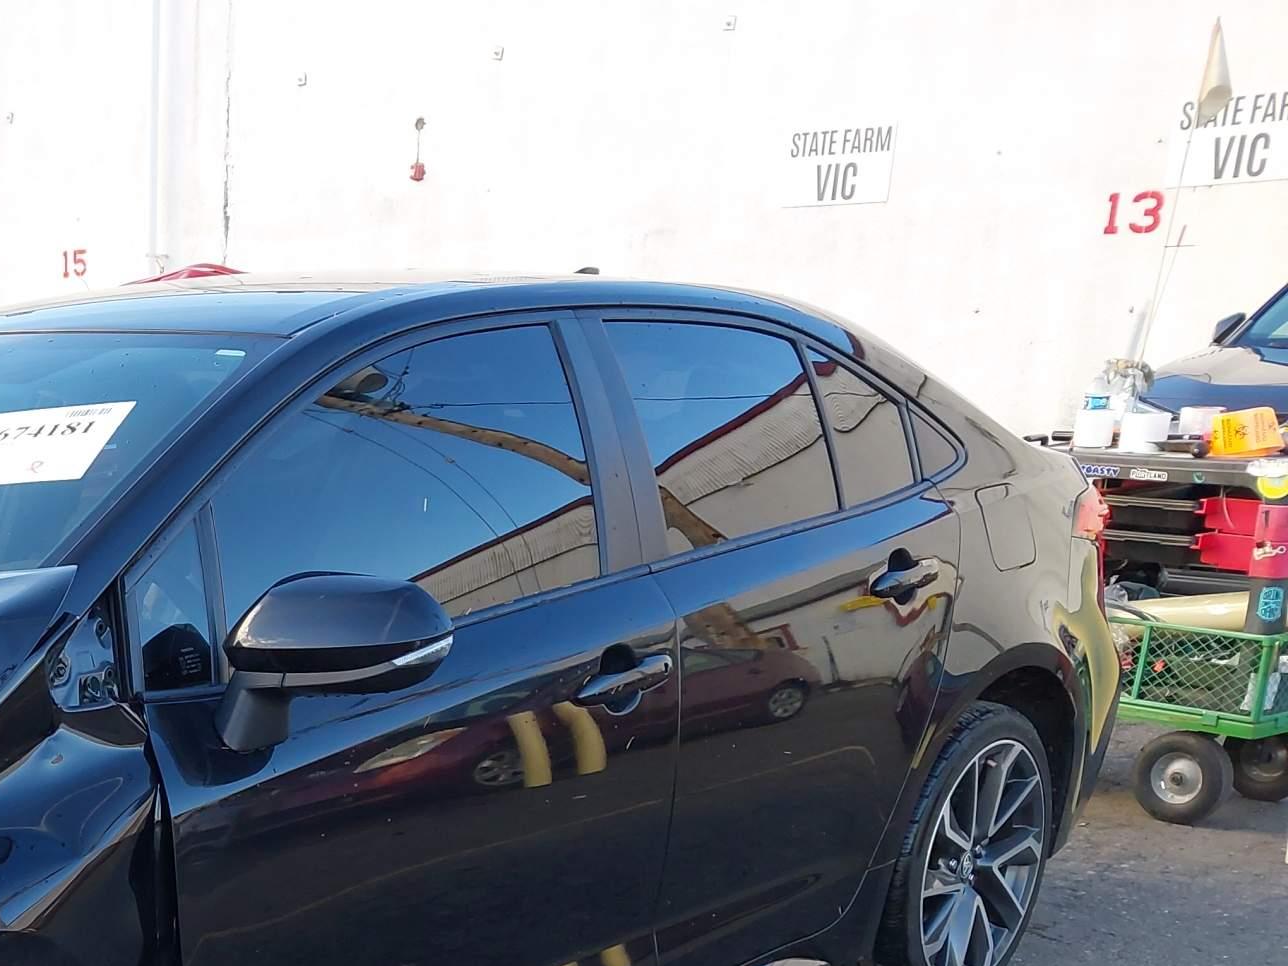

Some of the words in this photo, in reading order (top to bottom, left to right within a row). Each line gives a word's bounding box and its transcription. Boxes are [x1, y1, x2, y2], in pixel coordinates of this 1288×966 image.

[790, 129, 839, 158] STATE
[842, 125, 893, 155] FARM
[1213, 131, 1271, 180] VIC
[816, 161, 859, 202] VIC
[1103, 190, 1165, 235] 13
[62, 249, 88, 279] 15
